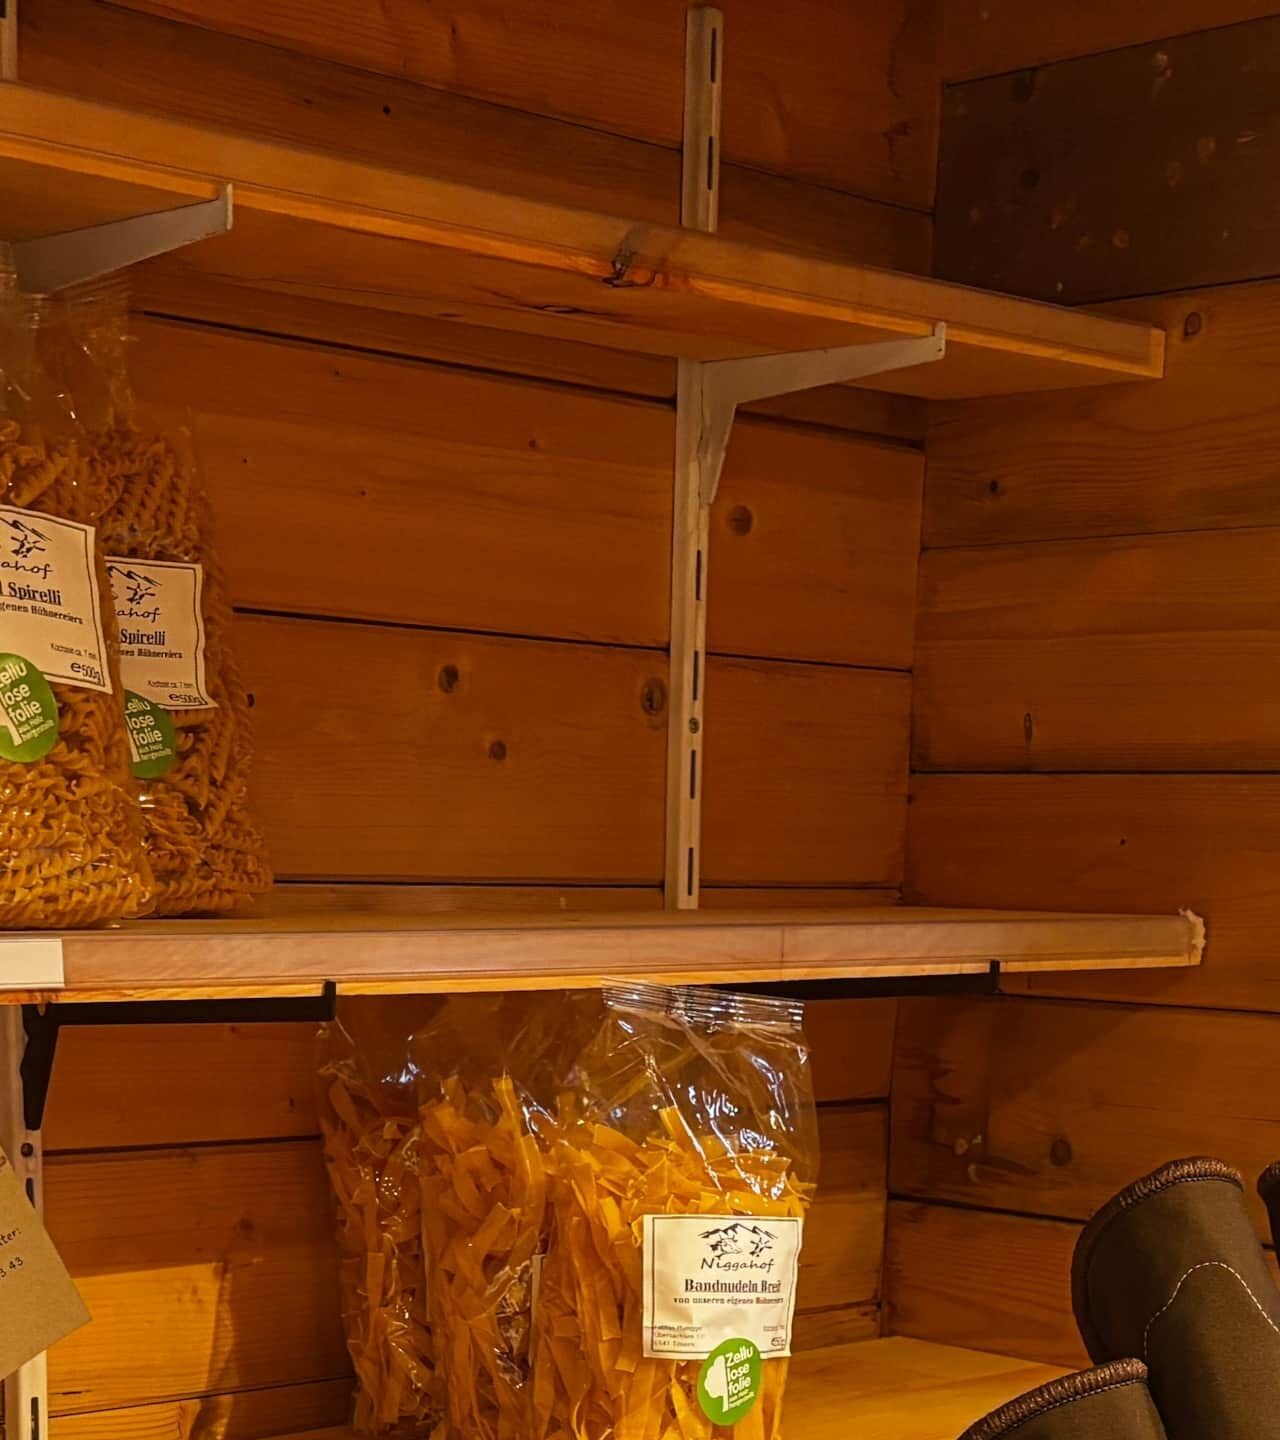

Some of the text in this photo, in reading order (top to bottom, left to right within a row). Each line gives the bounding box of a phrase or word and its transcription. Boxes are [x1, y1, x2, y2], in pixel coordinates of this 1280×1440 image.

[9, 582, 62, 605] Spirelli
[120, 629, 165, 645] Spirelli
[8, 701, 42, 725] folie
[126, 714, 155, 729] lose
[133, 728, 163, 746] folie
[9, 1257, 24, 1270] 43
[701, 1257, 774, 1272] Niggahof
[685, 1279, 757, 1293] Bandnudeln
[726, 1345, 753, 1367] Zellu
[727, 1362, 750, 1380] lose
[728, 1376, 751, 1395] folie
